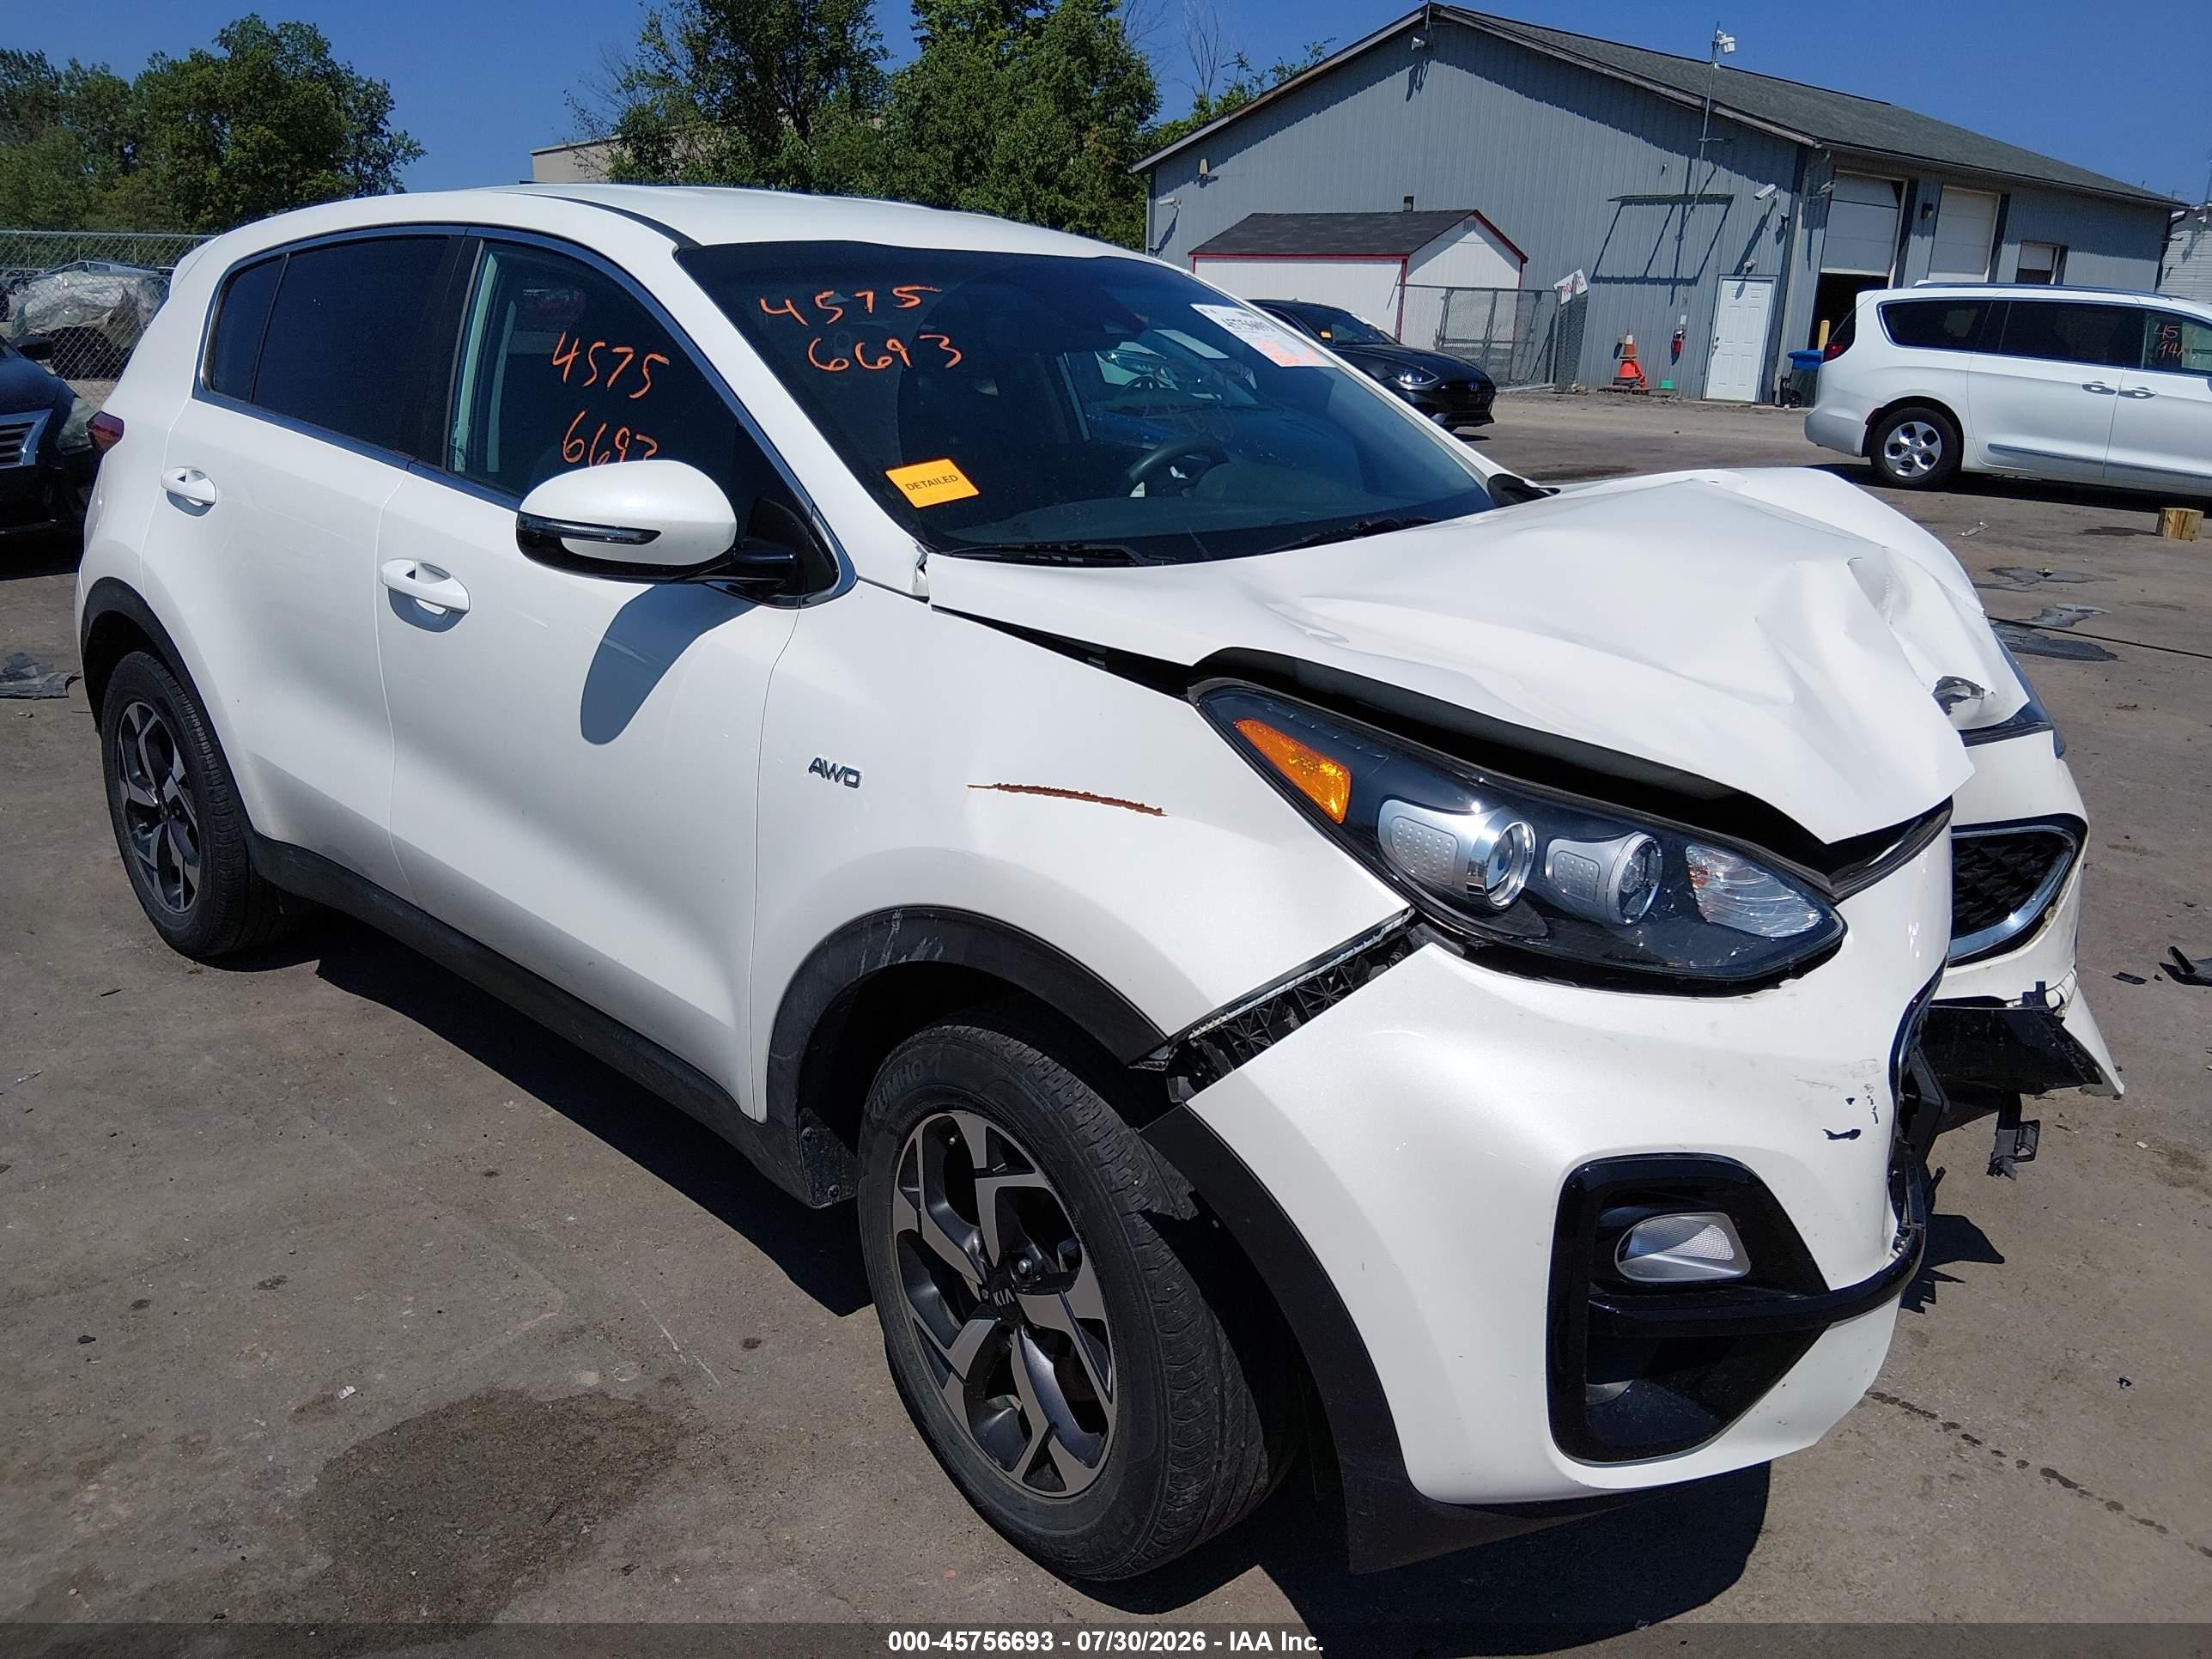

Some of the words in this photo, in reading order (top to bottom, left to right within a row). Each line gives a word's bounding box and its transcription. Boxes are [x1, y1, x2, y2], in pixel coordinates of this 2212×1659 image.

[759, 284, 943, 327] 4575
[550, 331, 671, 399] 4575
[808, 333, 963, 371] 6693
[905, 474, 959, 491] DETAILED
[808, 757, 861, 789] AWD
[992, 1287, 1015, 1307] KIA
